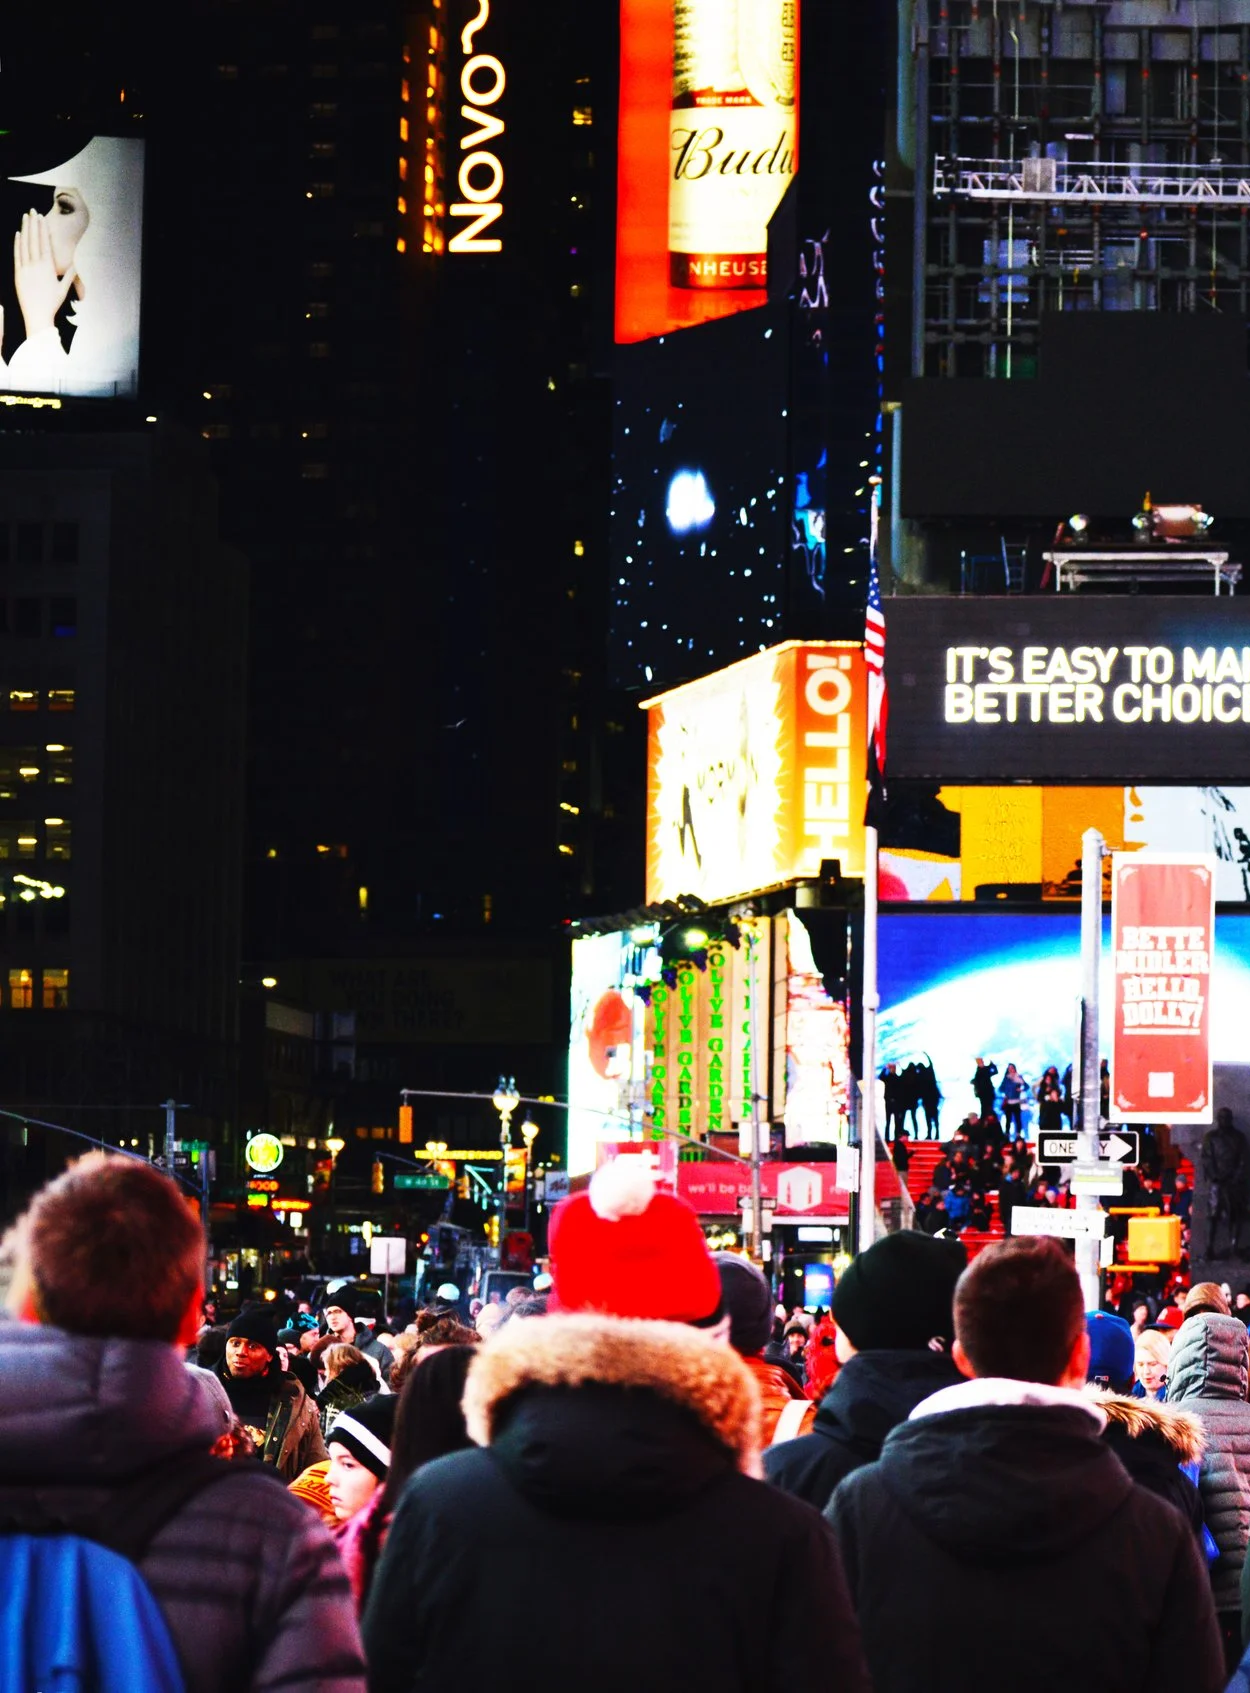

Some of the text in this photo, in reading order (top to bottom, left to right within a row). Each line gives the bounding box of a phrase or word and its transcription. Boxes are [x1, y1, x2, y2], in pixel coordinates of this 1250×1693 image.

[946, 646, 1014, 684] IT'S
[1022, 646, 1119, 684] EASY
[1123, 646, 1174, 684] TO
[944, 683, 1104, 723] BETTER
[804, 654, 852, 872] HELLO!
[1122, 926, 1205, 950] BETTE
[1116, 950, 1209, 974] MIDLER
[677, 971, 695, 1043] OLIVE
[1122, 1000, 1204, 1028] DOLLY!
[706, 953, 725, 1129] OLIVE GARDEN
[676, 1052, 693, 1136] GARDEN
[1049, 1141, 1075, 1155] ONE
[719, 1182, 736, 1195] be
[738, 1182, 768, 1195] bak
